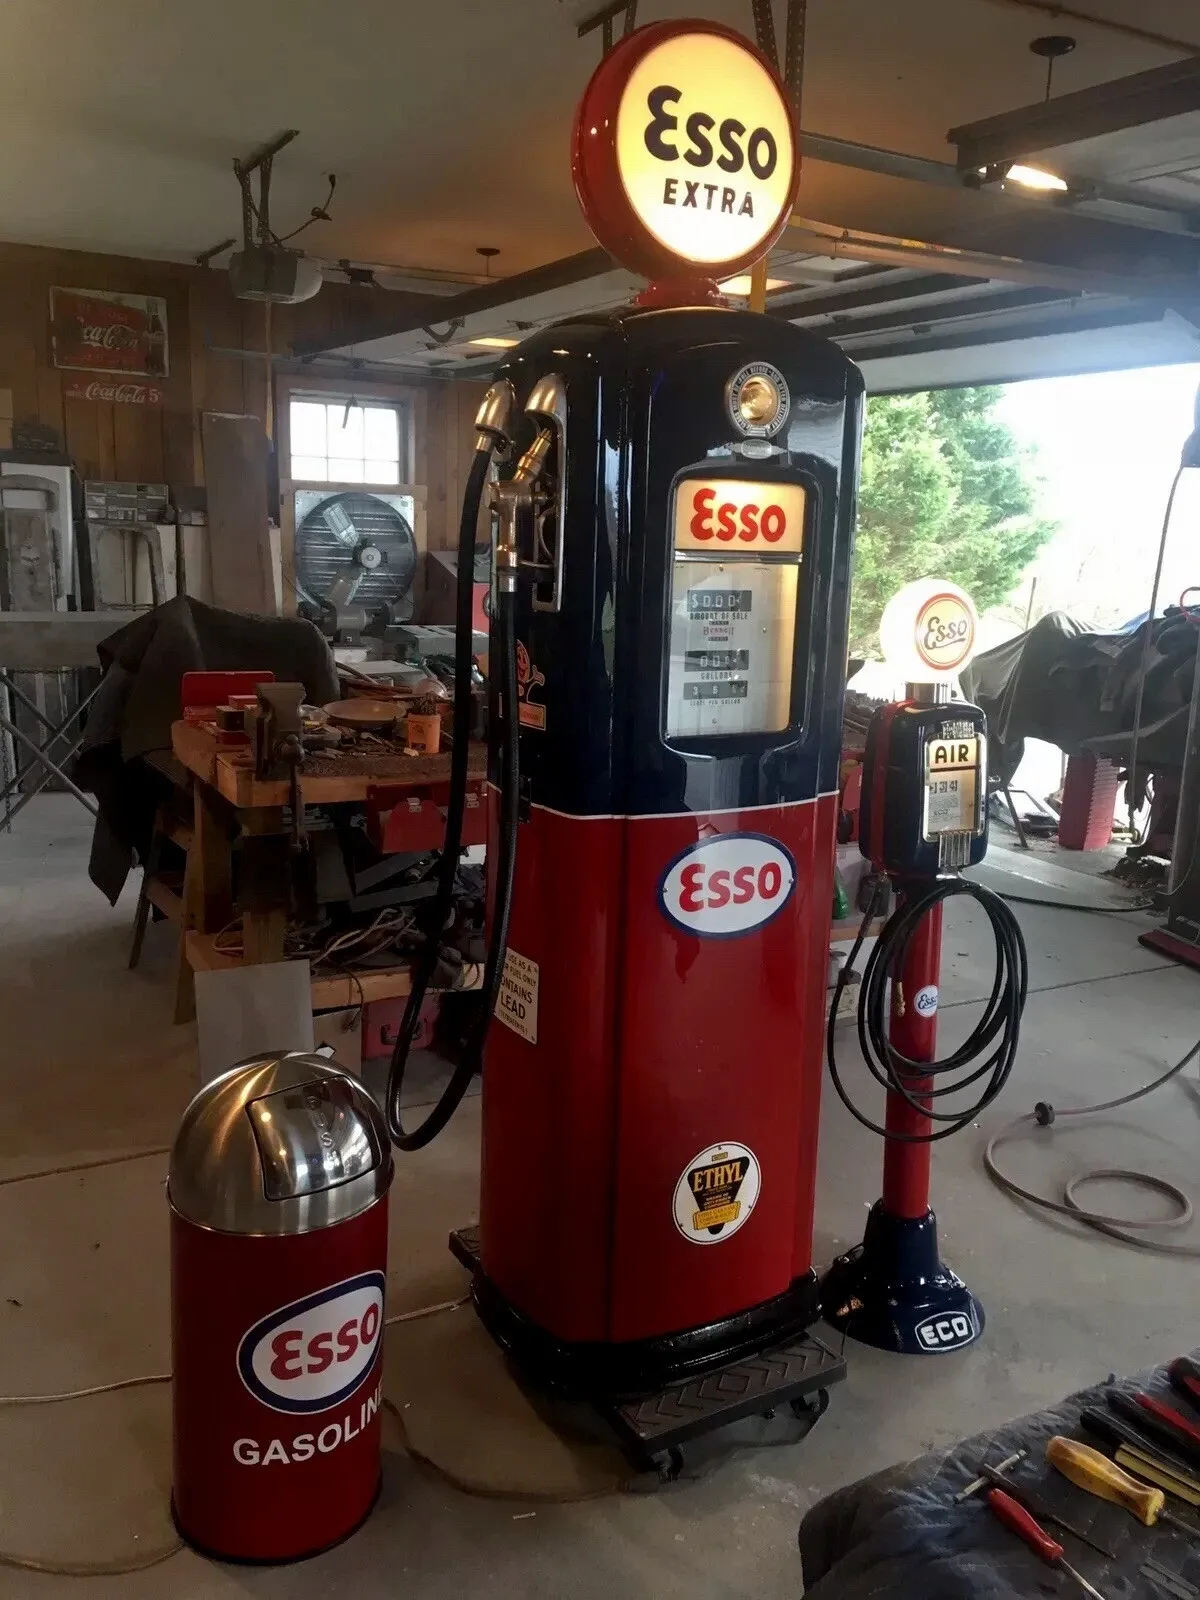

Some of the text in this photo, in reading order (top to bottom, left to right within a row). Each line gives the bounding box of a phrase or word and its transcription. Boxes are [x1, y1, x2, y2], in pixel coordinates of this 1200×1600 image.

[662, 177, 755, 219] EXTRA
[935, 743, 969, 764] AIR
[501, 976, 533, 1004] ONTAINS
[501, 991, 526, 1020] LEAD
[693, 1161, 744, 1193] ETHYL
[920, 1316, 969, 1346] ECO
